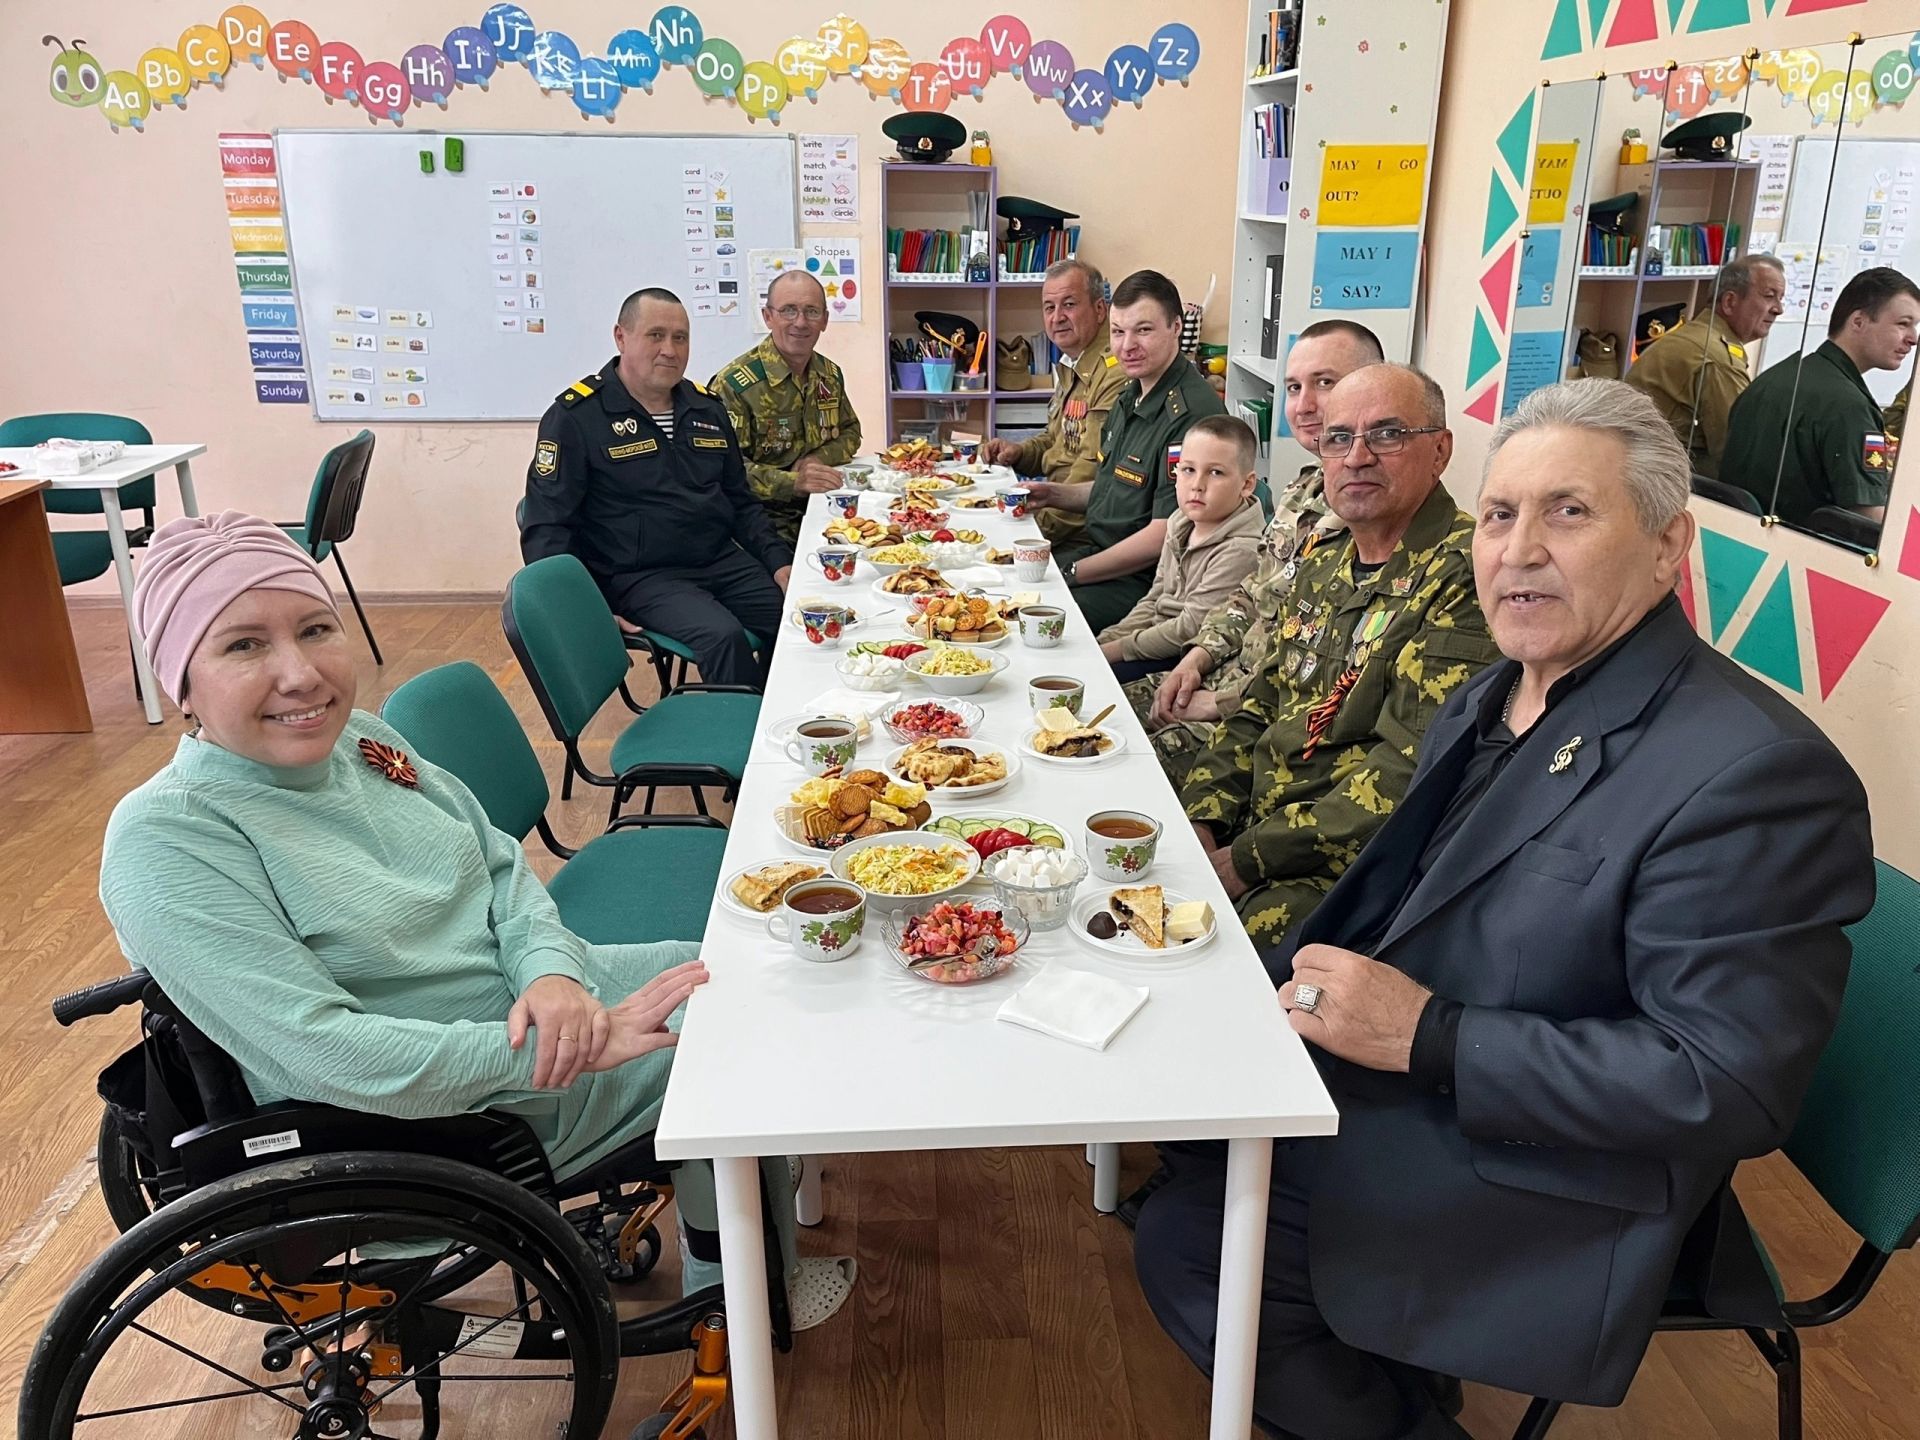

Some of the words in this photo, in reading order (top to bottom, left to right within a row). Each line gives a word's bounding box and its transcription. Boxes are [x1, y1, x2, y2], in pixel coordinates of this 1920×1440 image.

[104, 82, 140, 110] Aa
[144, 60, 181, 87] Bb
[185, 39, 219, 66] Cc
[224, 17, 262, 48] Dd
[274, 32, 310, 61] Ee
[322, 56, 354, 84] Ff
[364, 75, 402, 106] Gg
[405, 56, 444, 86] Hh
[454, 39, 485, 69] Ii
[493, 16, 520, 49] Jj
[582, 69, 605, 99] Ll
[613, 47, 651, 69] Mm
[655, 19, 694, 47] Nn
[696, 52, 734, 80] Oo
[744, 73, 778, 107] Pp
[779, 51, 814, 81] Qq
[824, 29, 859, 59] Rr
[870, 50, 899, 81] Ss
[910, 74, 938, 104] Tt
[946, 52, 981, 80] Uu
[988, 28, 1024, 59] Vv
[1029, 54, 1067, 82] Ww
[1069, 81, 1104, 109] Xx
[1113, 60, 1146, 90] Yy
[1157, 38, 1189, 66] Zz
[803, 140, 822, 148] write
[223, 153, 271, 168] Monday
[1330, 160, 1360, 171] MAY
[1377, 160, 1382, 170] I
[1399, 159, 1418, 170] GO
[804, 185, 822, 193] draw
[1325, 191, 1359, 201] OUT?
[228, 190, 277, 207] Tuesday
[686, 208, 703, 216] farm
[814, 245, 850, 259] Shapes
[1340, 247, 1378, 260] MAY
[1385, 247, 1391, 259] I
[239, 270, 290, 285] Thursday
[1342, 285, 1381, 298] SAY?
[251, 308, 287, 322] Friday
[251, 346, 301, 362] Saturday
[260, 383, 303, 398] Sunday
